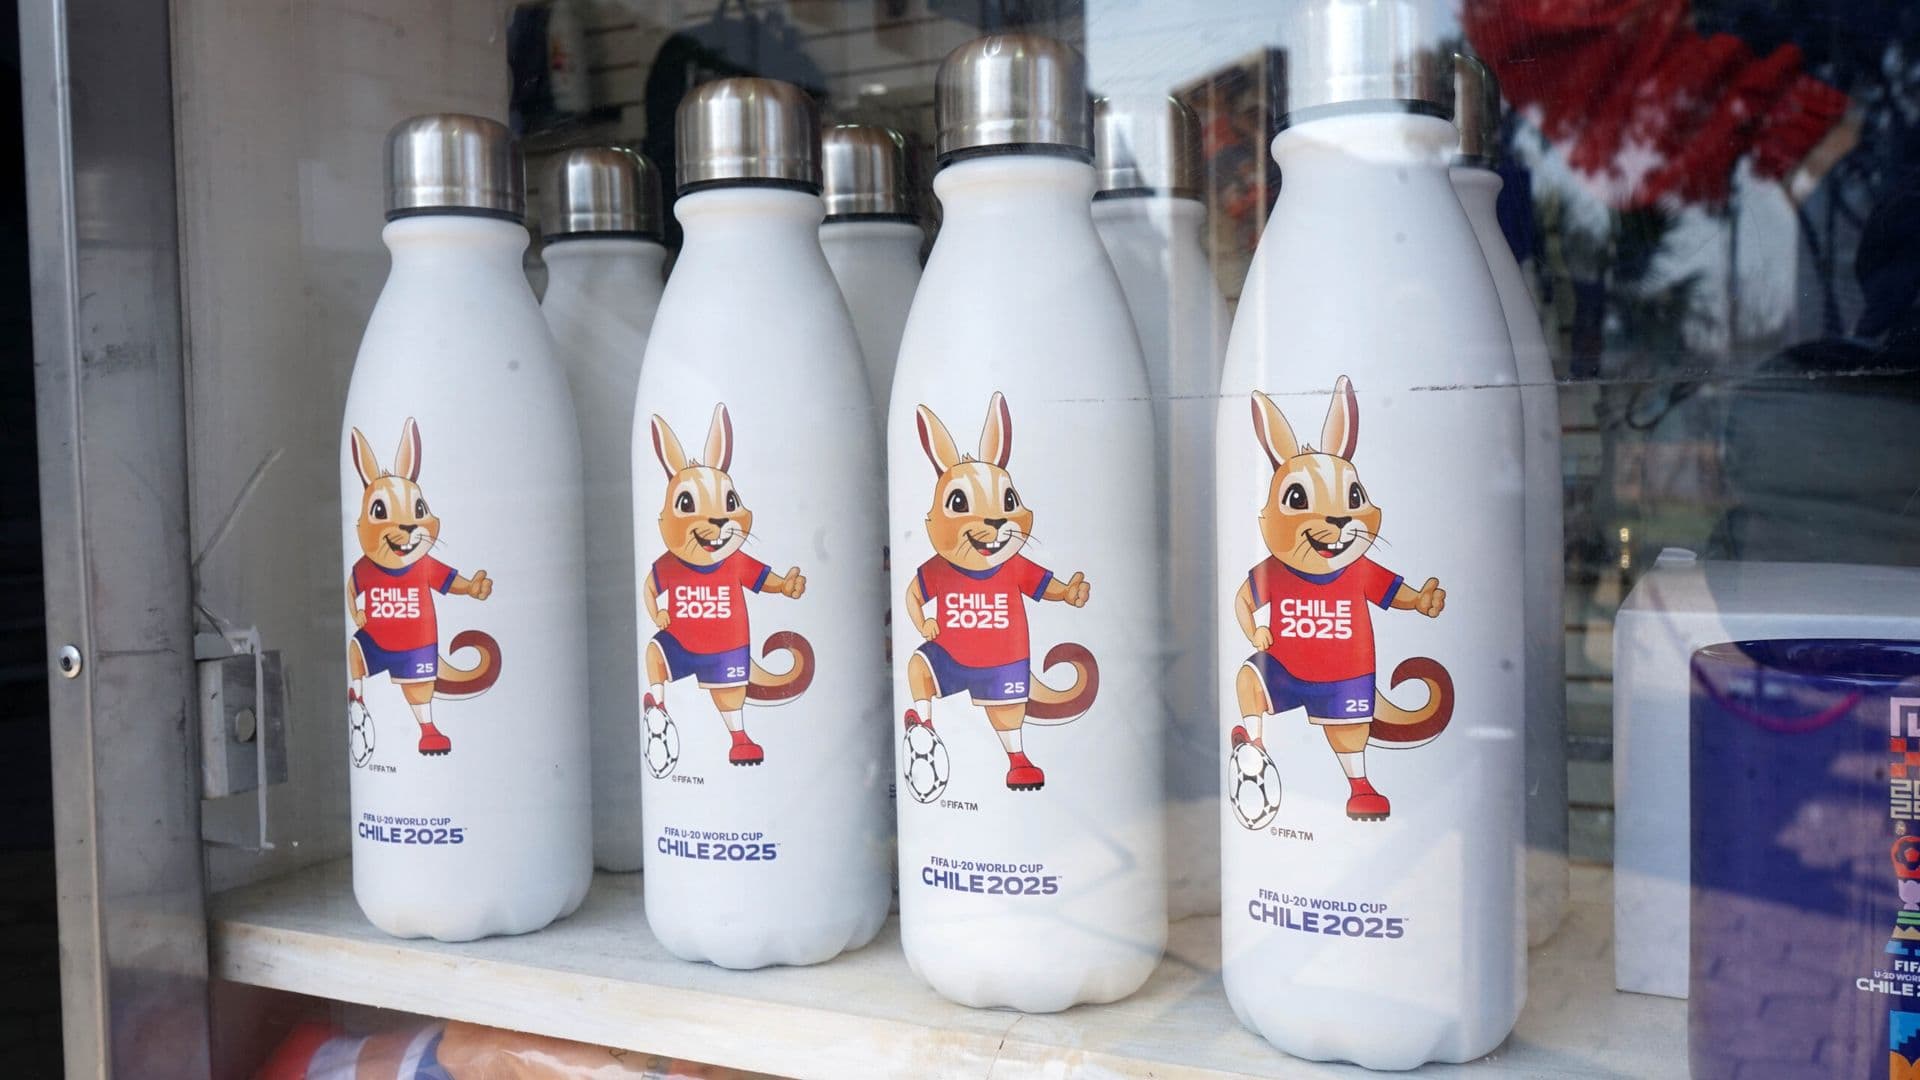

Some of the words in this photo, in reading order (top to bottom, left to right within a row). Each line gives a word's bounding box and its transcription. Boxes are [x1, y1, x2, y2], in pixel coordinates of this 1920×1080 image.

[370, 587, 419, 602] CHILE
[675, 585, 730, 601] CHILE
[945, 592, 1008, 610] CHILE
[371, 602, 421, 618] 2025
[675, 601, 731, 619] 2025
[1279, 598, 1351, 618] CHILE
[946, 610, 1009, 629] 2025
[1280, 618, 1352, 640] 2025
[416, 663, 434, 674] 25
[726, 667, 745, 678] 25
[1004, 682, 1025, 694] 25
[1345, 699, 1369, 712] 25
[363, 813, 376, 822] FIFA
[377, 816, 393, 824] U-20
[394, 817, 428, 826] WORLD
[429, 818, 451, 826] CUP
[358, 822, 402, 843] CHILE
[664, 827, 679, 837] FIFA
[681, 830, 700, 839] U-20
[702, 832, 739, 841] WORLD
[741, 832, 763, 841] CUP
[657, 837, 710, 860] CHILE
[931, 856, 949, 868] FIFA
[951, 860, 974, 871] U-20
[976, 862, 1017, 873] WORLD
[1019, 863, 1043, 874] CUP
[922, 867, 984, 893] CHILE
[1259, 888, 1280, 903] FIFA
[1282, 894, 1307, 907] U-20
[1310, 898, 1357, 913] WORLD
[1360, 902, 1387, 914] CUP
[1248, 900, 1319, 934] CHILE
[1856, 977, 1914, 997] CHILE
